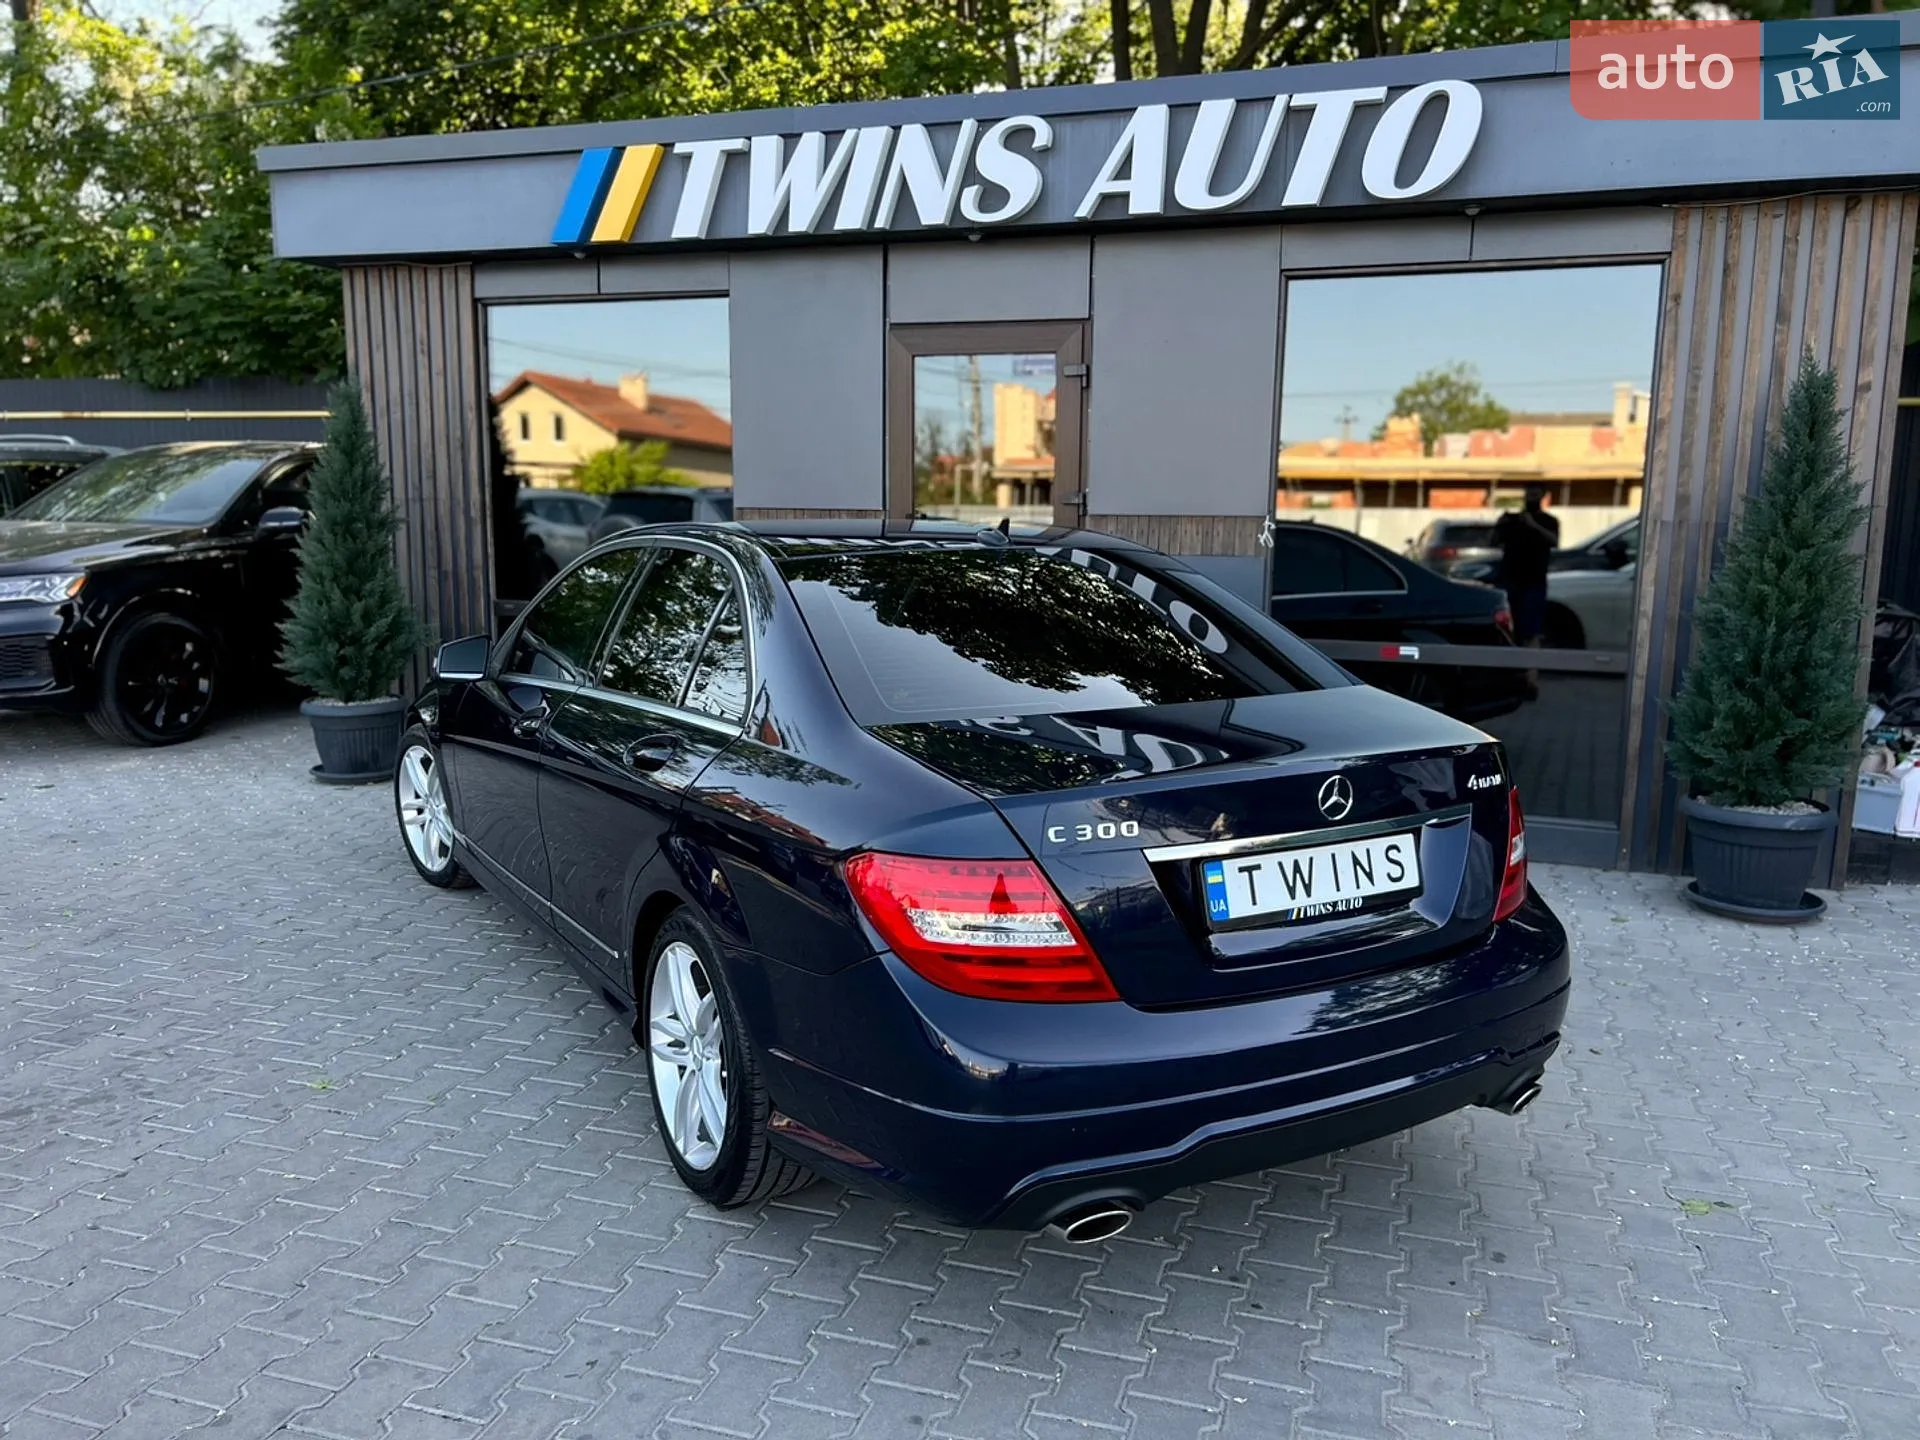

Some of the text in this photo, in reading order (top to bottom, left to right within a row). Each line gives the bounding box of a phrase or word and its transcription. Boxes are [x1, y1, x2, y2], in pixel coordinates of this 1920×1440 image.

[671, 79, 1483, 240] TWINS AUTO
[1047, 821, 1139, 843] C 300
[1238, 844, 1405, 906] TWINS
[1210, 899, 1227, 913] UA
[1299, 897, 1363, 918] TWINS AUTO
